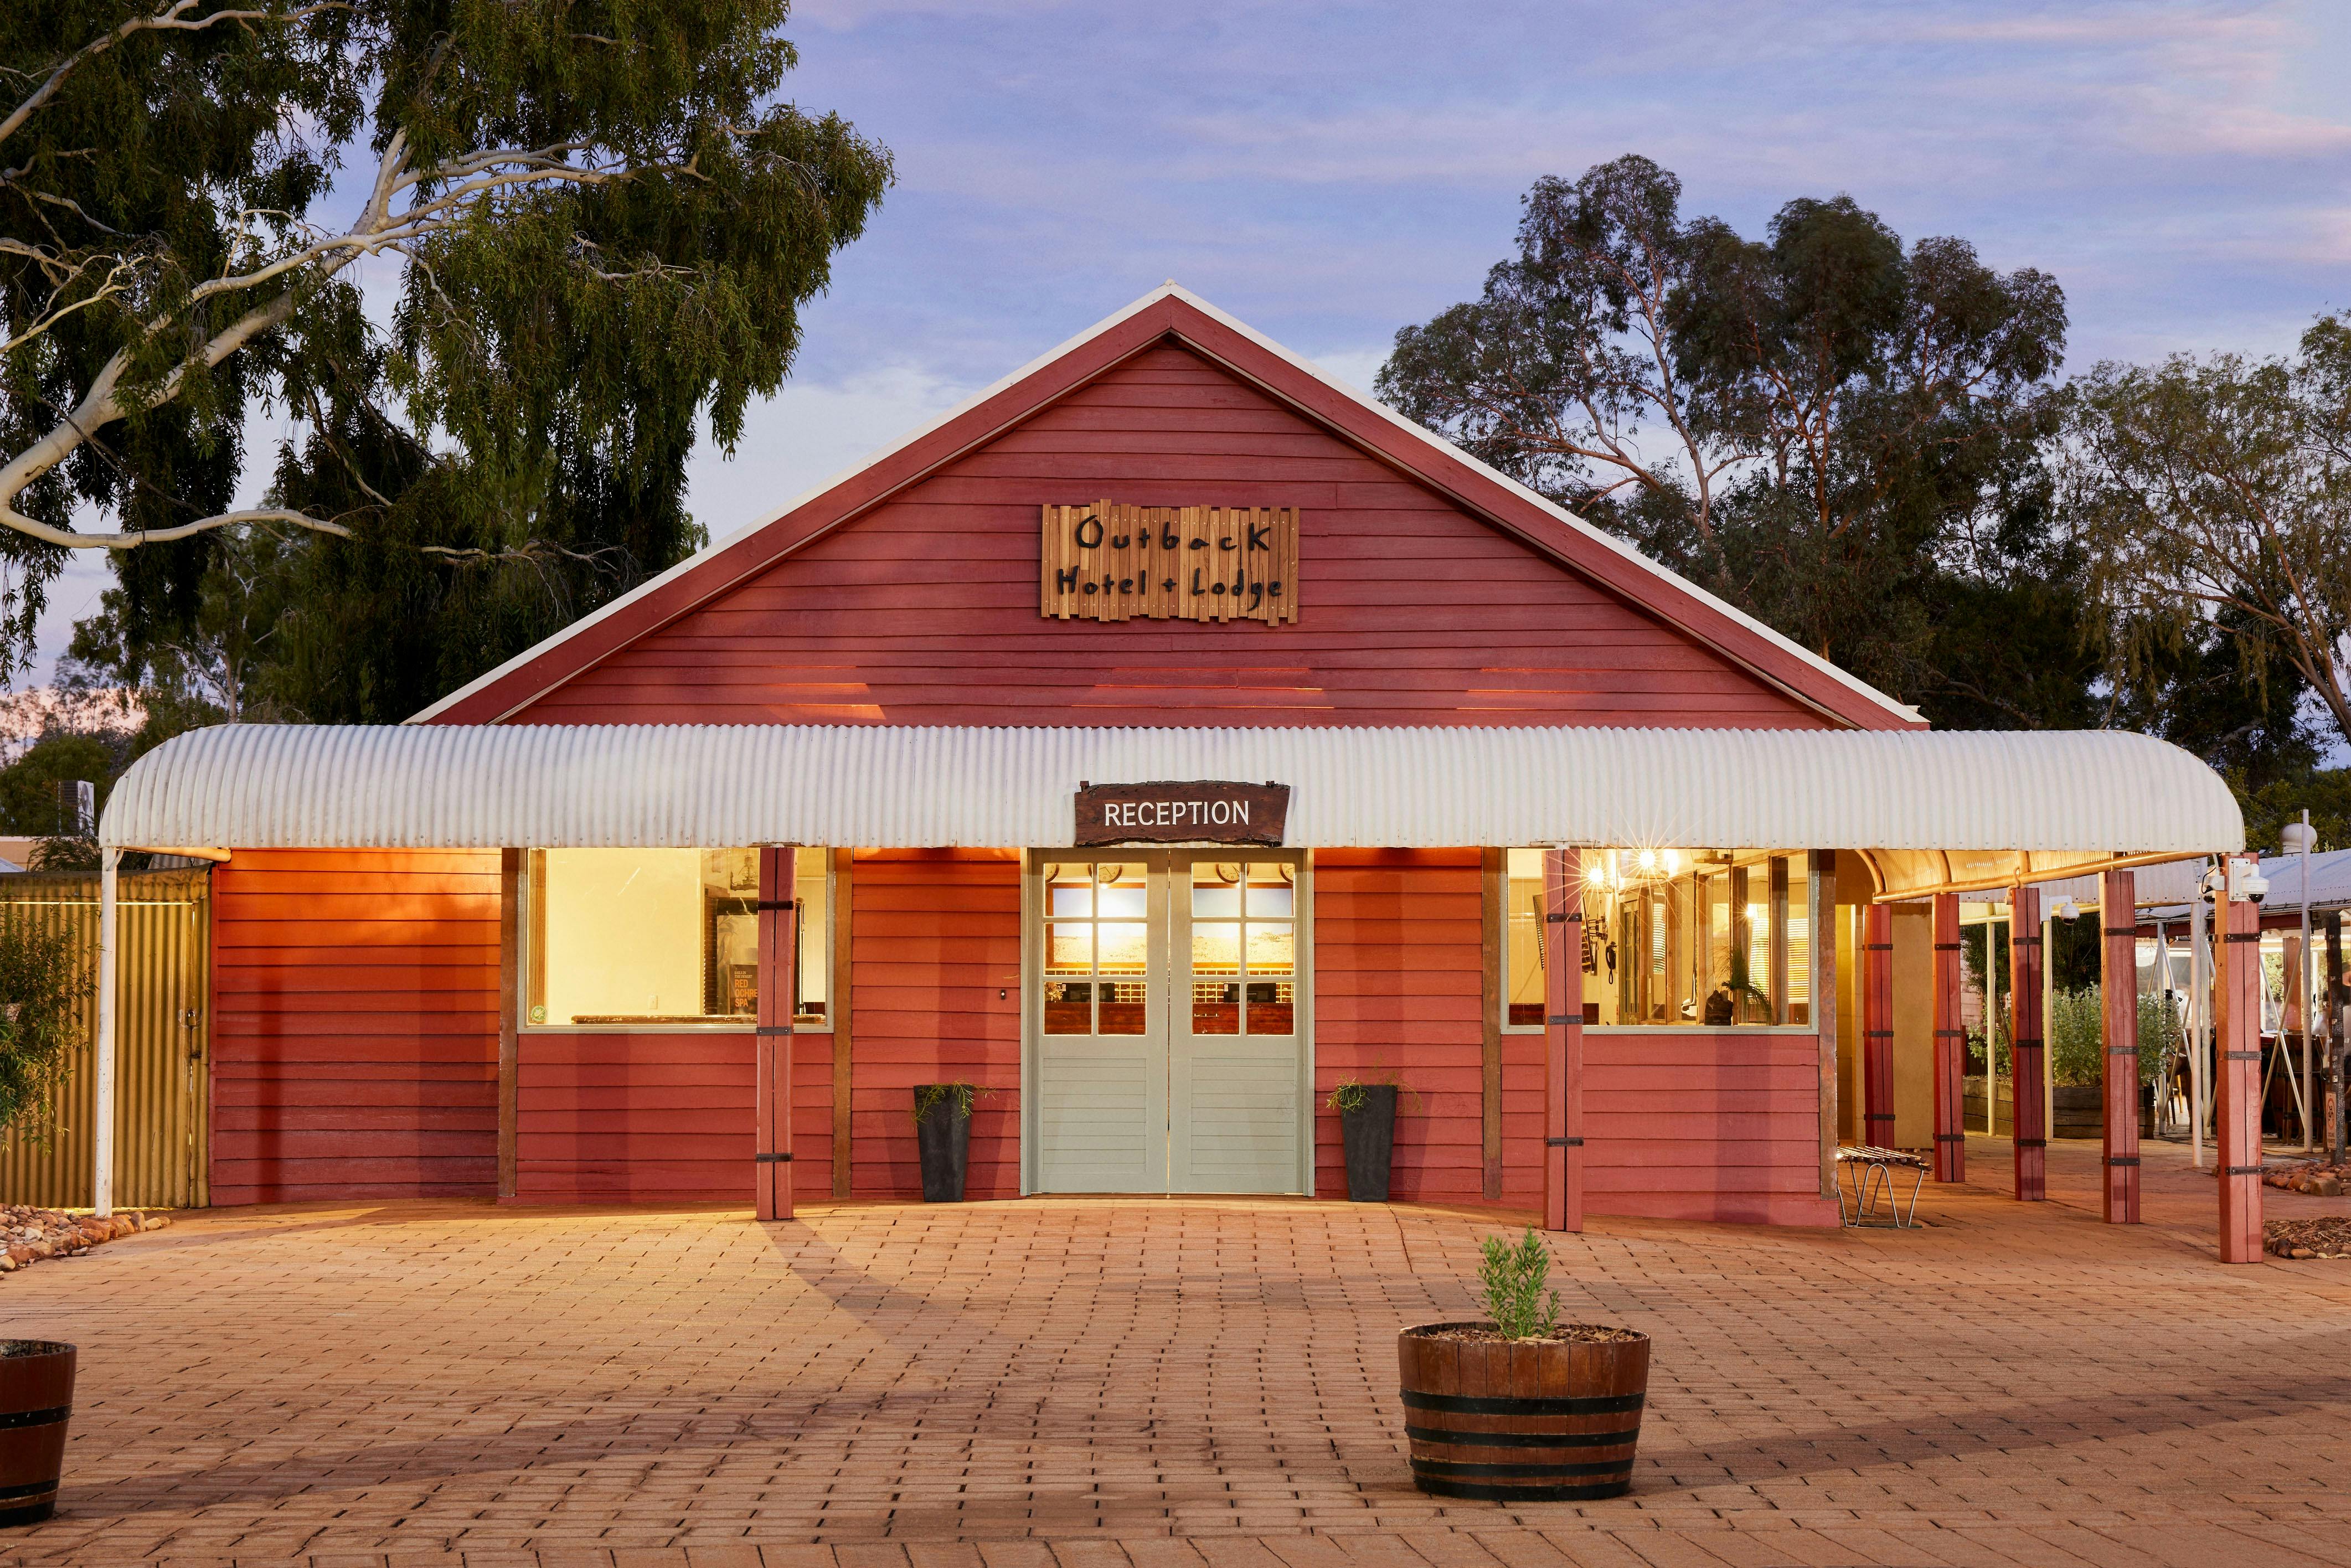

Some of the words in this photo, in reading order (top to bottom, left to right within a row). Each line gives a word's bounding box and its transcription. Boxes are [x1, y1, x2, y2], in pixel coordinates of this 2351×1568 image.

[1058, 565, 1146, 595] Hotel
[1192, 568, 1282, 611] Lodge
[1105, 801, 1249, 826] RECEPTION
[735, 979, 749, 988] RED
[735, 988, 758, 997] OCHRE
[735, 998, 749, 1007] SPA
